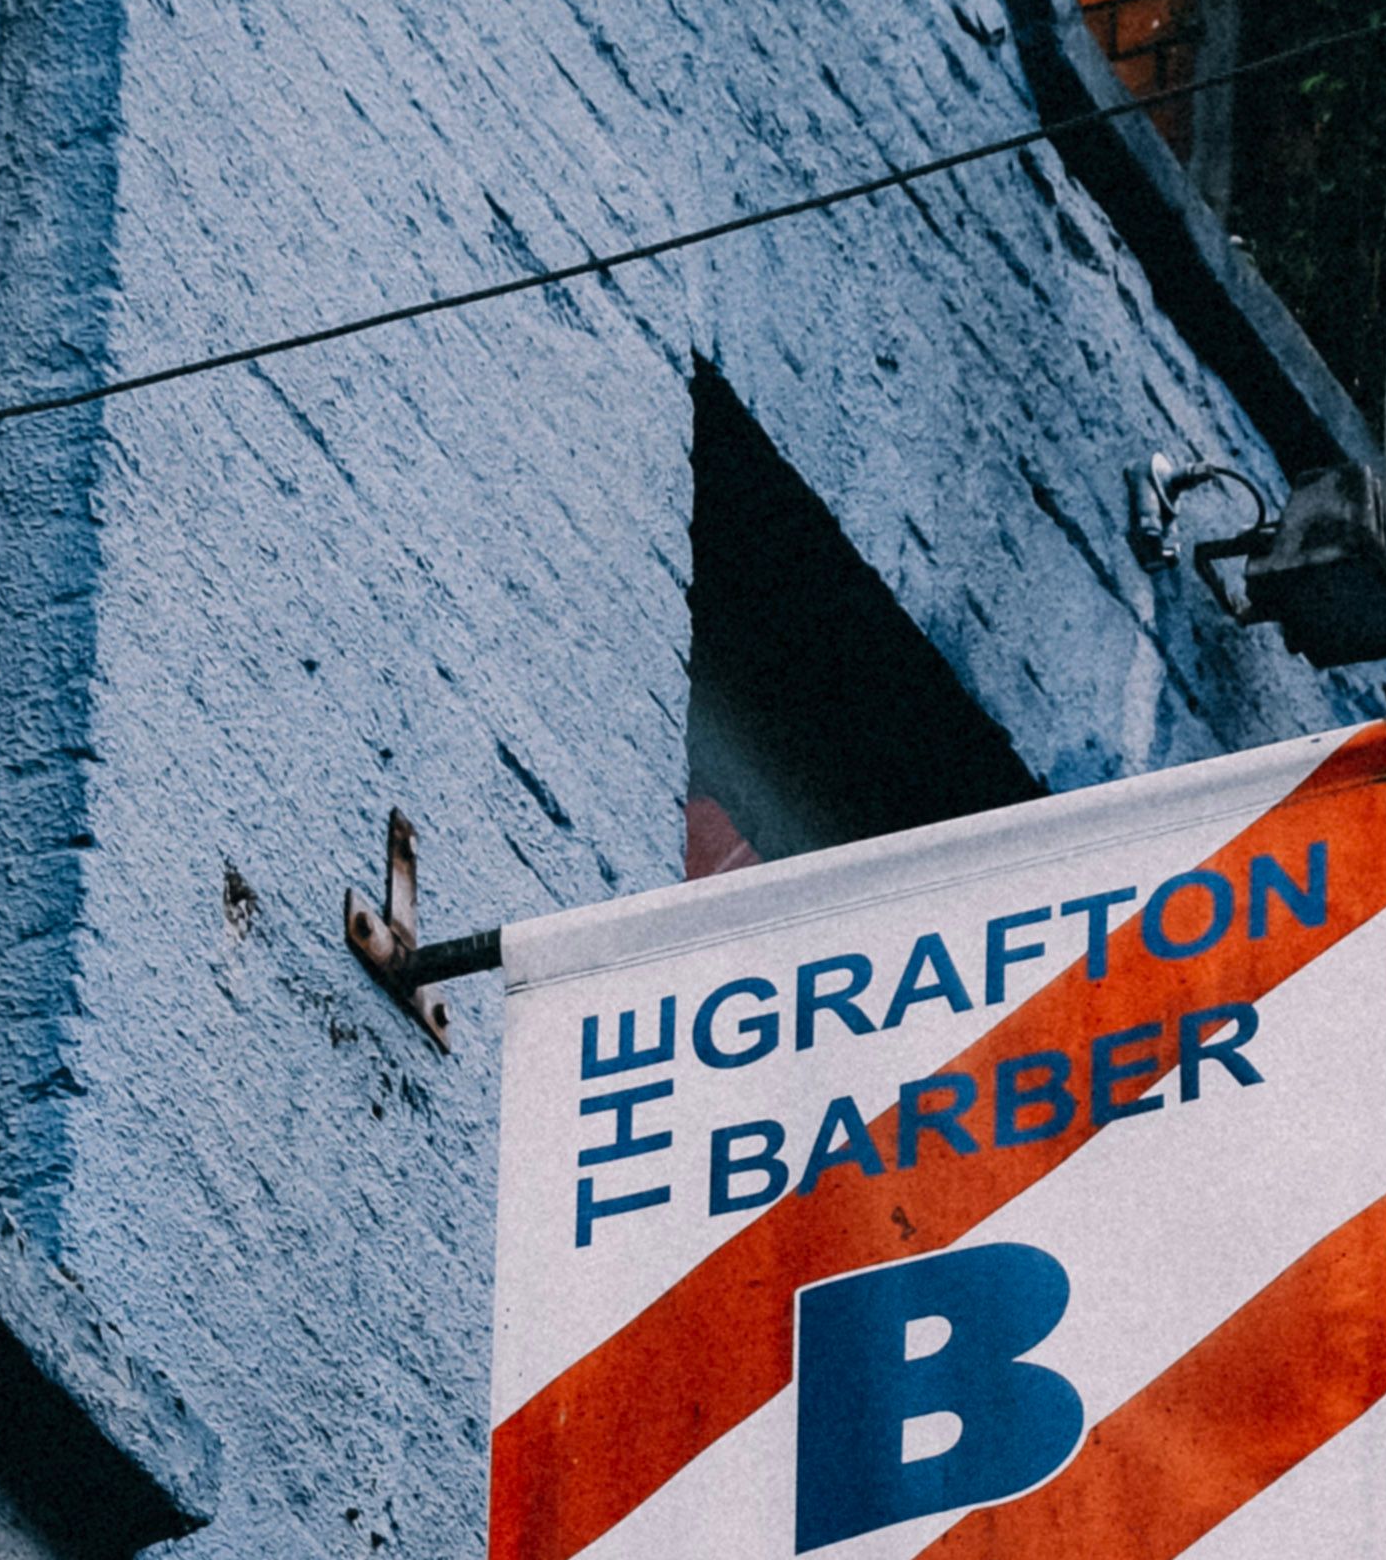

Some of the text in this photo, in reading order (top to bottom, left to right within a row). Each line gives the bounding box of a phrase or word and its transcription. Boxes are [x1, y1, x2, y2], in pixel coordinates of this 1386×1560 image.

[574, 840, 1330, 1249] THE GRAFTON
[707, 999, 1266, 1218] BARBER
